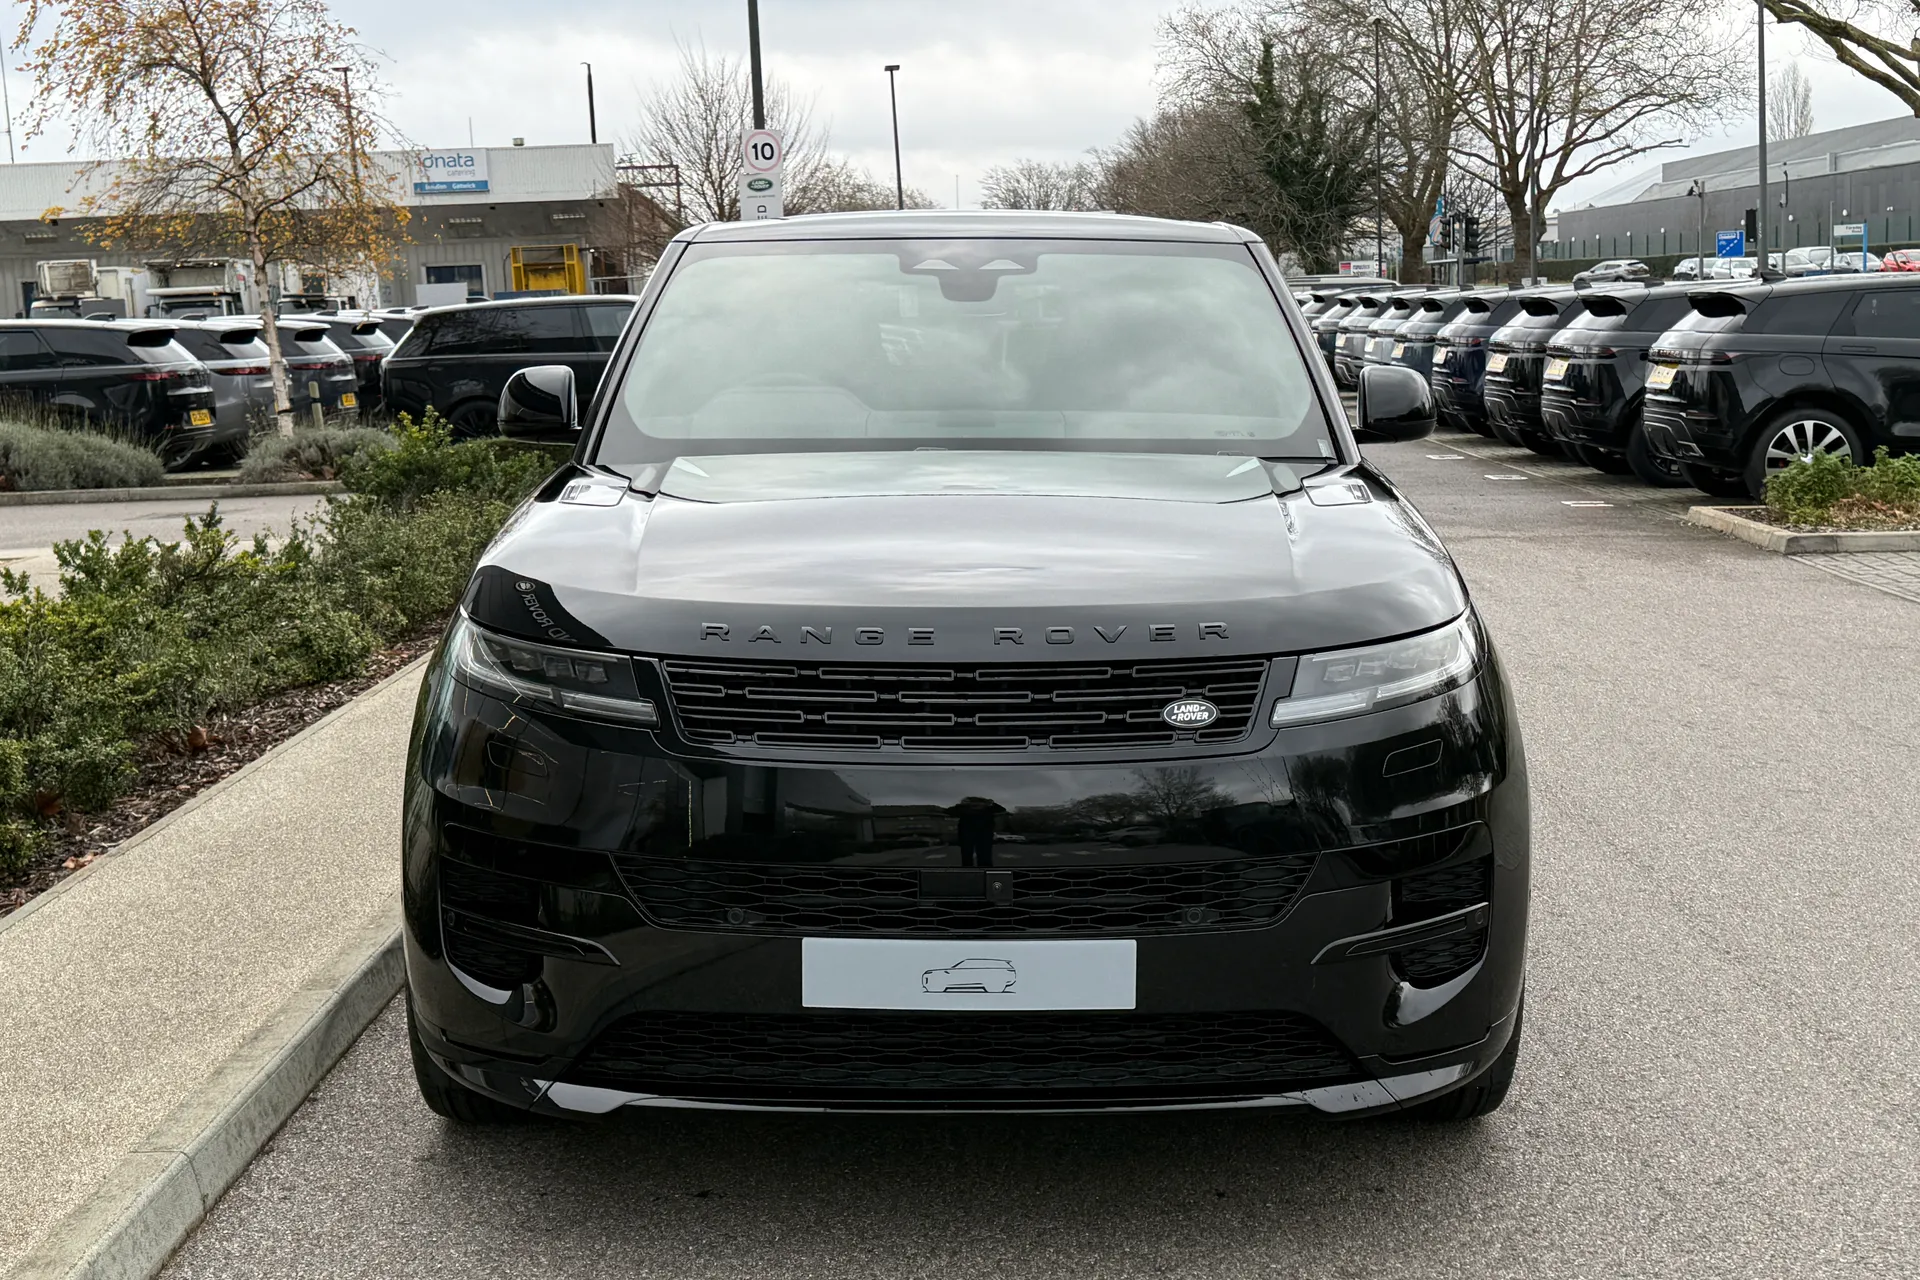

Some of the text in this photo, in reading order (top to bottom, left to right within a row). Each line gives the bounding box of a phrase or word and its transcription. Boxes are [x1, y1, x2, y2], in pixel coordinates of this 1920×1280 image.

[752, 142, 774, 160] 10
[423, 153, 474, 168] dnata
[701, 621, 1229, 645] RANGE ROVER
[1174, 704, 1199, 713] LAND
[1177, 711, 1209, 721] ROVER
